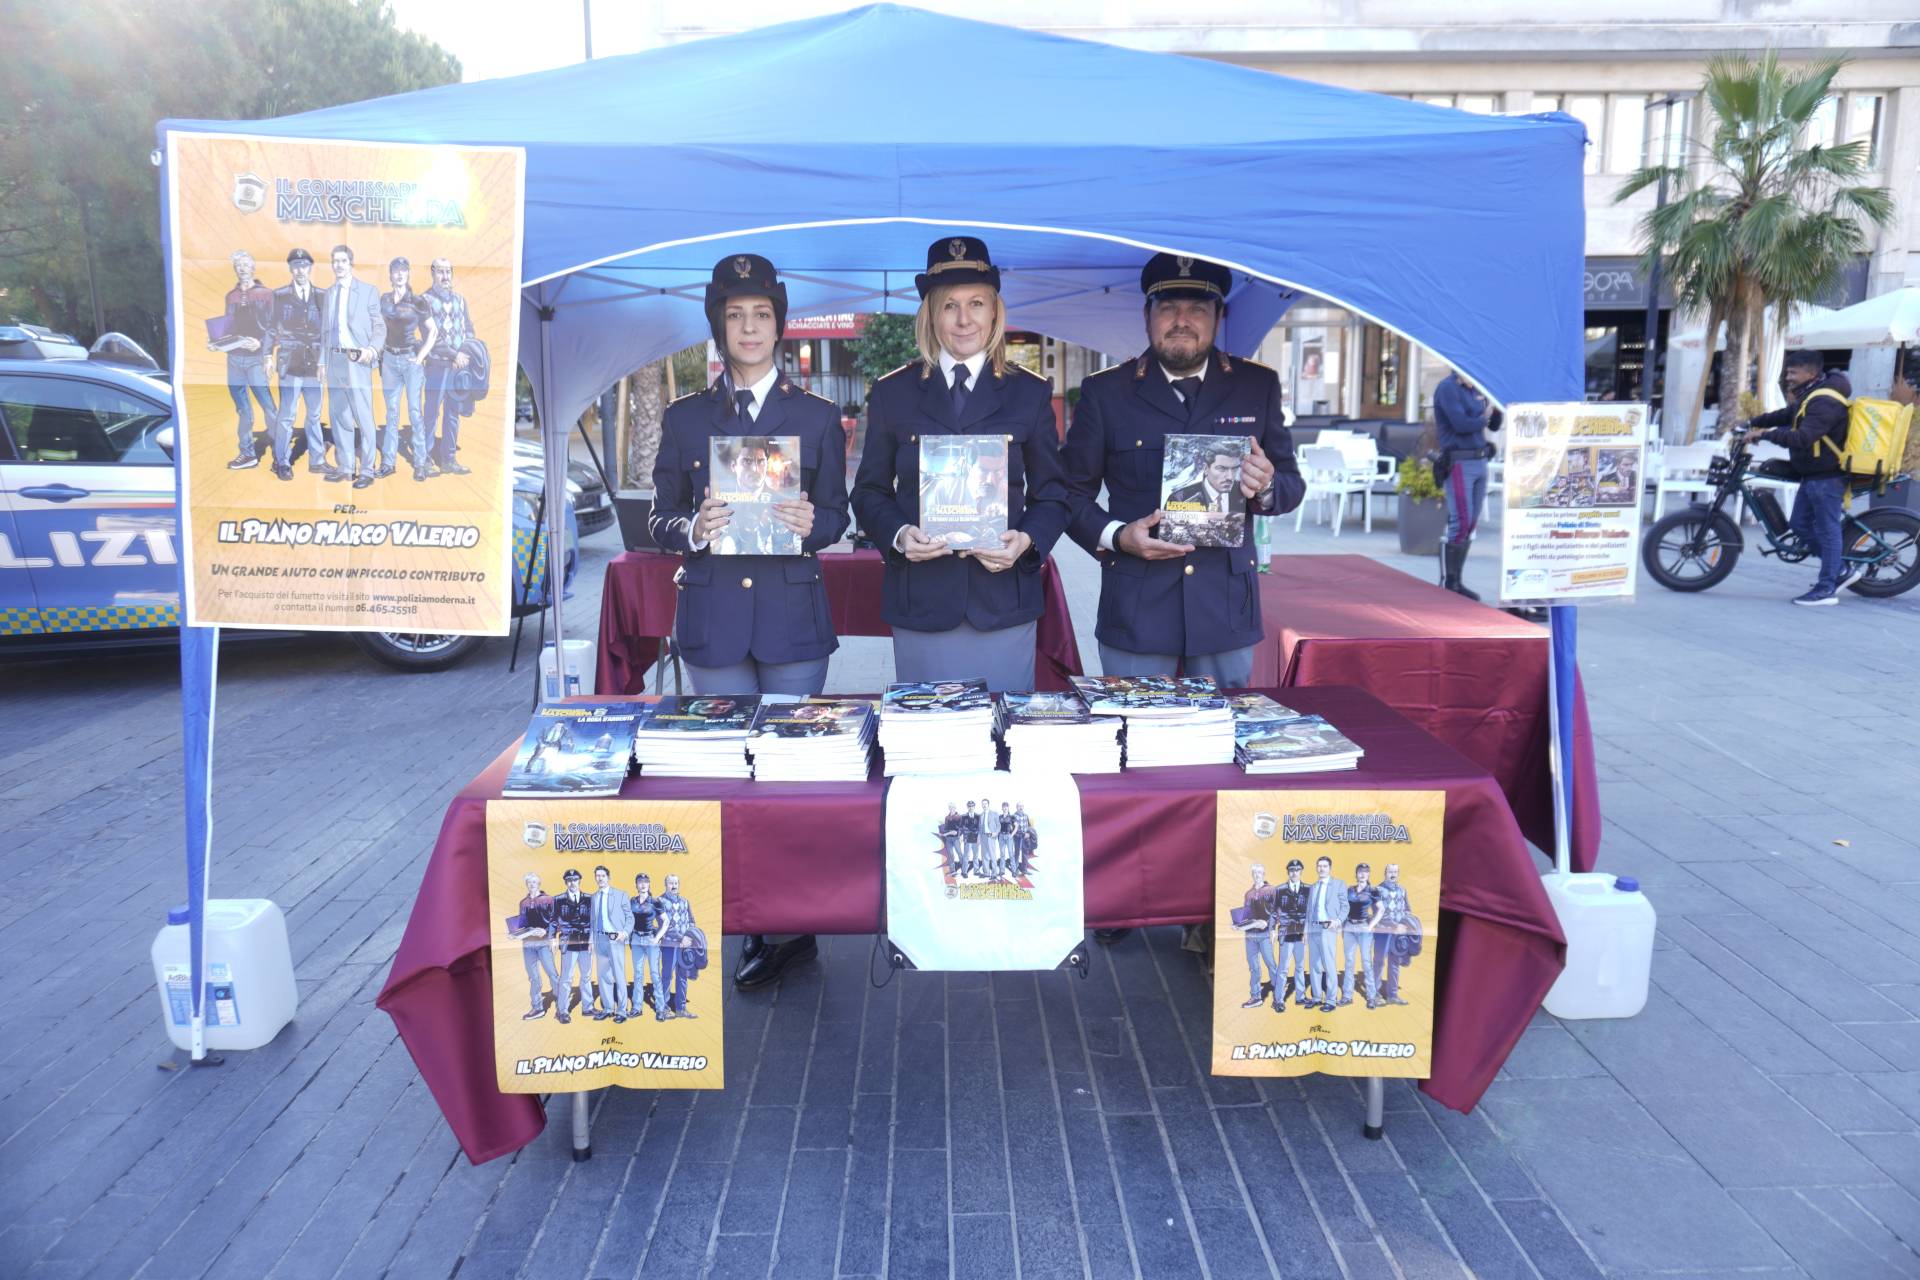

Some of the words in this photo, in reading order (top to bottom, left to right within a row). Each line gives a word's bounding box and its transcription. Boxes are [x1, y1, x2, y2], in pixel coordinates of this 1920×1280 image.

[275, 178, 292, 195] IL
[787, 322, 831, 330] SCHIACCIATE
[837, 321, 855, 329] VINO
[217, 520, 241, 544] IL
[241, 517, 314, 549] PIANO
[314, 518, 389, 547] MARCO
[389, 519, 480, 548] VALERIO
[211, 564, 229, 576] UN
[231, 565, 279, 577] GRANDE
[281, 566, 317, 578] AIUTO
[319, 567, 344, 579] CON
[360, 568, 408, 580] PICCOLO
[409, 569, 486, 582] CONTRIBUTO
[218, 588, 233, 598] Per
[276, 590, 289, 599] del
[291, 590, 326, 601] fumetto
[372, 593, 476, 606] www.poliziamoderna.it
[281, 602, 317, 612] contatta
[355, 602, 418, 615] 06.465.25518
[553, 823, 566, 834] IL
[567, 823, 666, 834] COMMISSARIO
[1282, 813, 1297, 825] IL
[1299, 813, 1392, 826] COMMISSARIO
[553, 833, 688, 852] MASCHERPA
[1282, 824, 1411, 843] MASCHERPA
[1232, 1045, 1248, 1060] IL
[1248, 1040, 1297, 1061] PIANO
[1298, 1036, 1348, 1056] MARCO
[1350, 1040, 1416, 1058] VALERIO
[515, 1058, 533, 1075] IL
[532, 1053, 586, 1075] PIANO
[586, 1048, 641, 1069] MARCO
[641, 1051, 708, 1072] VALERIO
